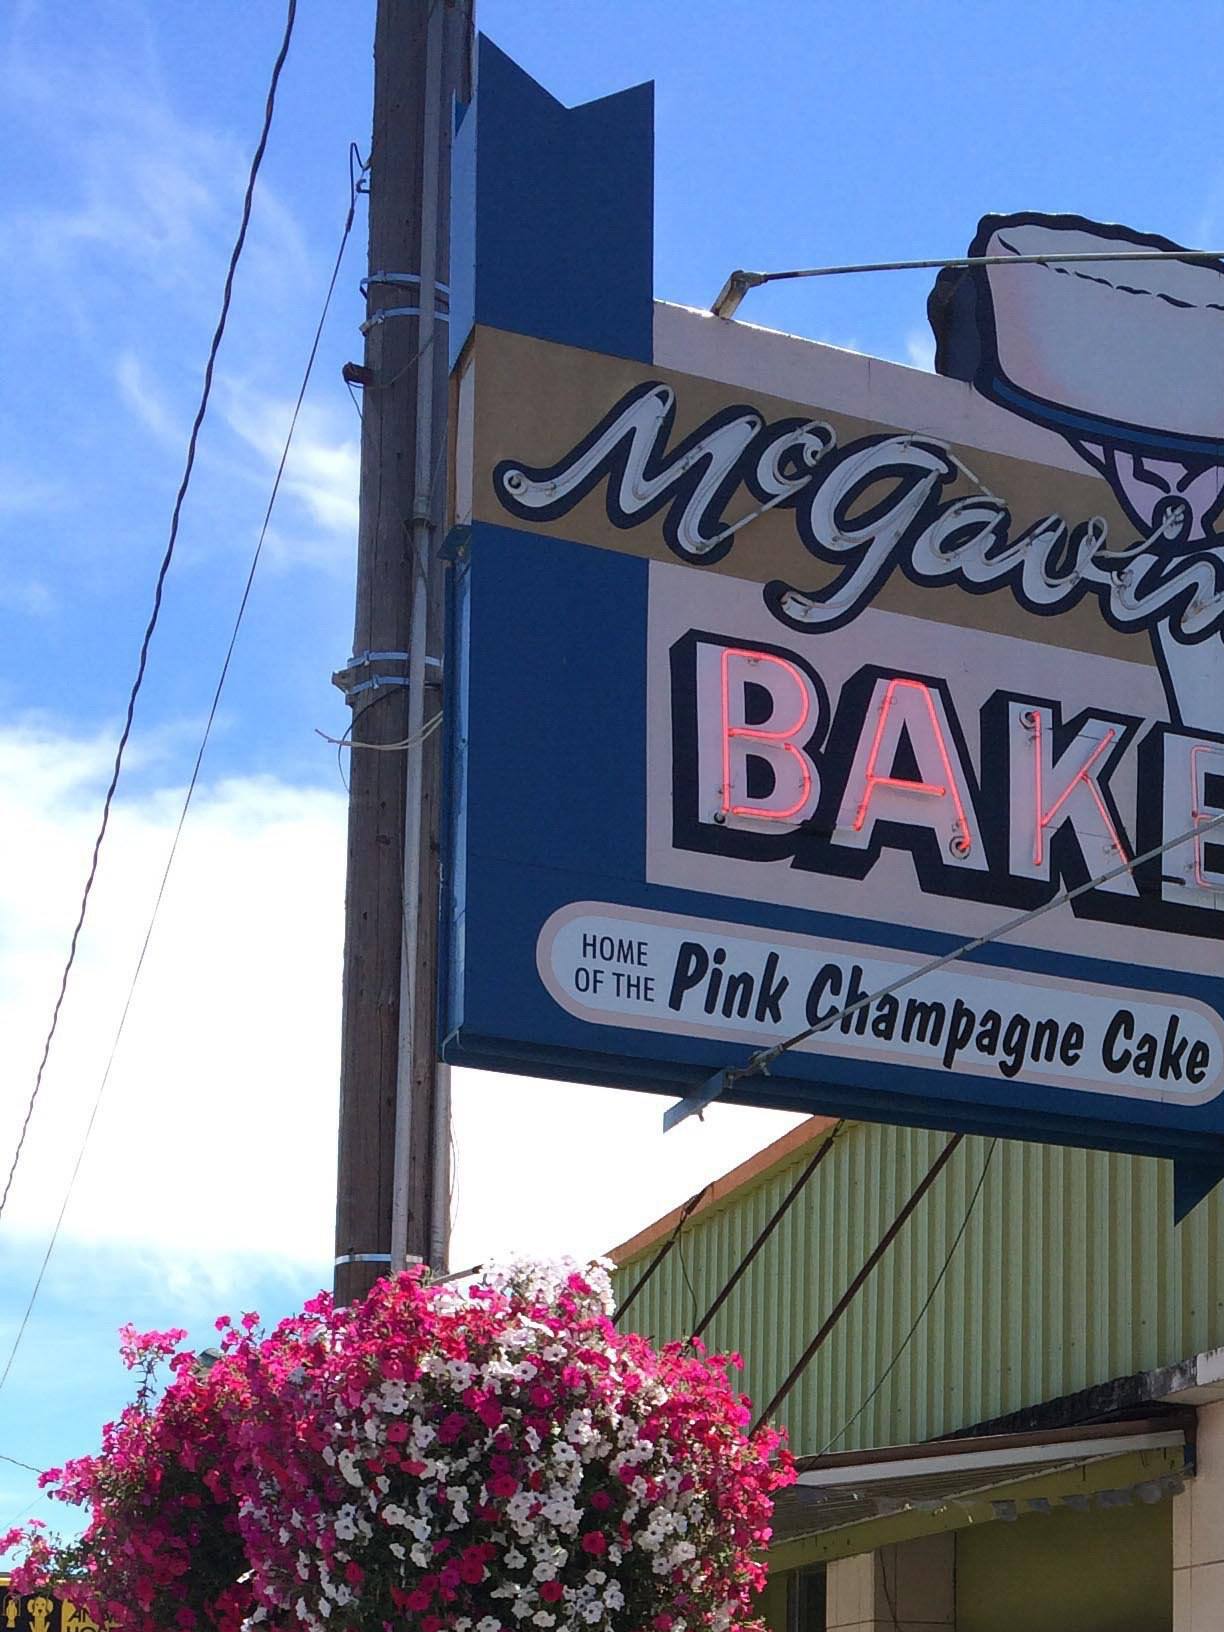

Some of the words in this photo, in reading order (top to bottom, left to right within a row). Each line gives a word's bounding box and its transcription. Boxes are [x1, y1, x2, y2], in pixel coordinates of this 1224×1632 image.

[581, 933, 649, 967] HOME
[574, 967, 604, 994] OF
[611, 971, 655, 1002] THE
[668, 941, 790, 1024] Pink
[805, 963, 1084, 1077] Champagne
[1103, 1009, 1210, 1084] Cake
